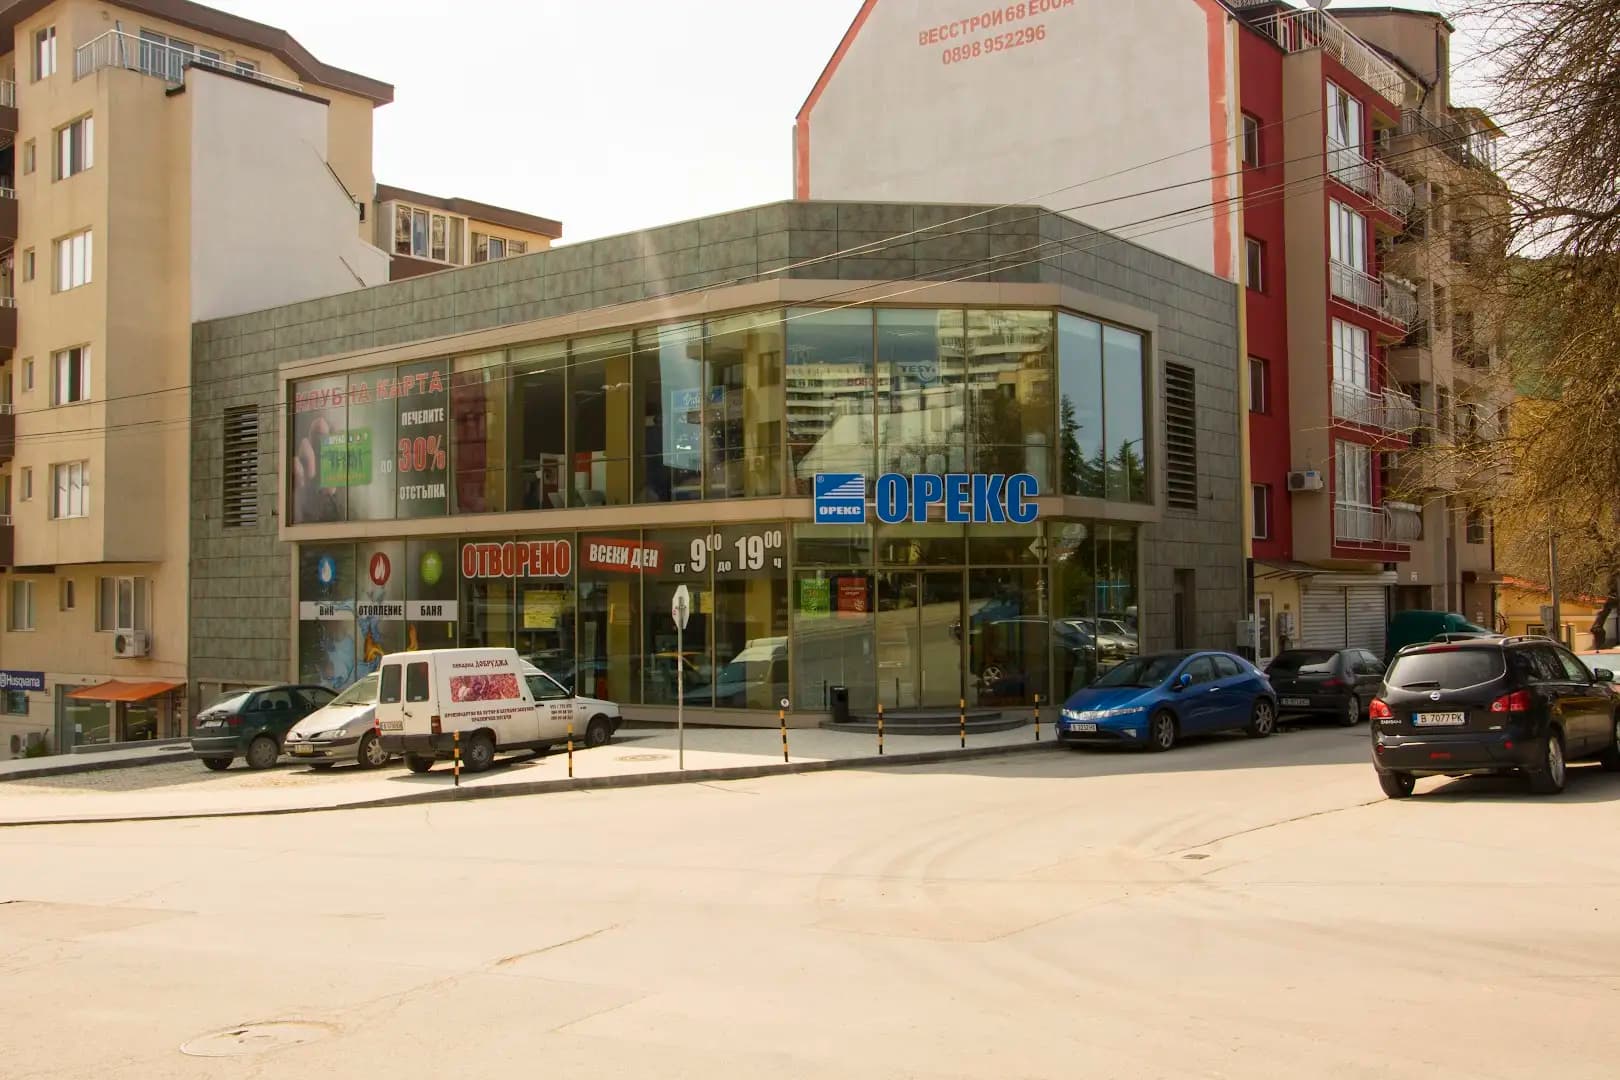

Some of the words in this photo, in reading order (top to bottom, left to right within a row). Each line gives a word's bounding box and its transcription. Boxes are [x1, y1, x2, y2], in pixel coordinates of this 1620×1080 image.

[1005, 3, 1025, 21] 68
[942, 41, 981, 65] 0898
[984, 24, 1046, 54] 952296
[376, 369, 443, 399] КАРТА
[401, 407, 444, 426] ПЕЧЕЛИТЕ
[399, 434, 446, 472] 30%
[400, 483, 445, 501] ОТСТЪПКА
[875, 473, 1040, 524] ОРЕКС
[819, 506, 861, 515] ОРЕКС
[462, 539, 571, 578] ОТВОРЕНО
[590, 543, 629, 565] ВСЕКИ
[630, 547, 658, 569] ДЕН
[674, 564, 685, 573] от
[717, 561, 731, 573] до
[773, 558, 782, 568] ч
[358, 605, 402, 616] ОТОПЛЕНИЕ
[420, 605, 442, 616] БАНЯ
